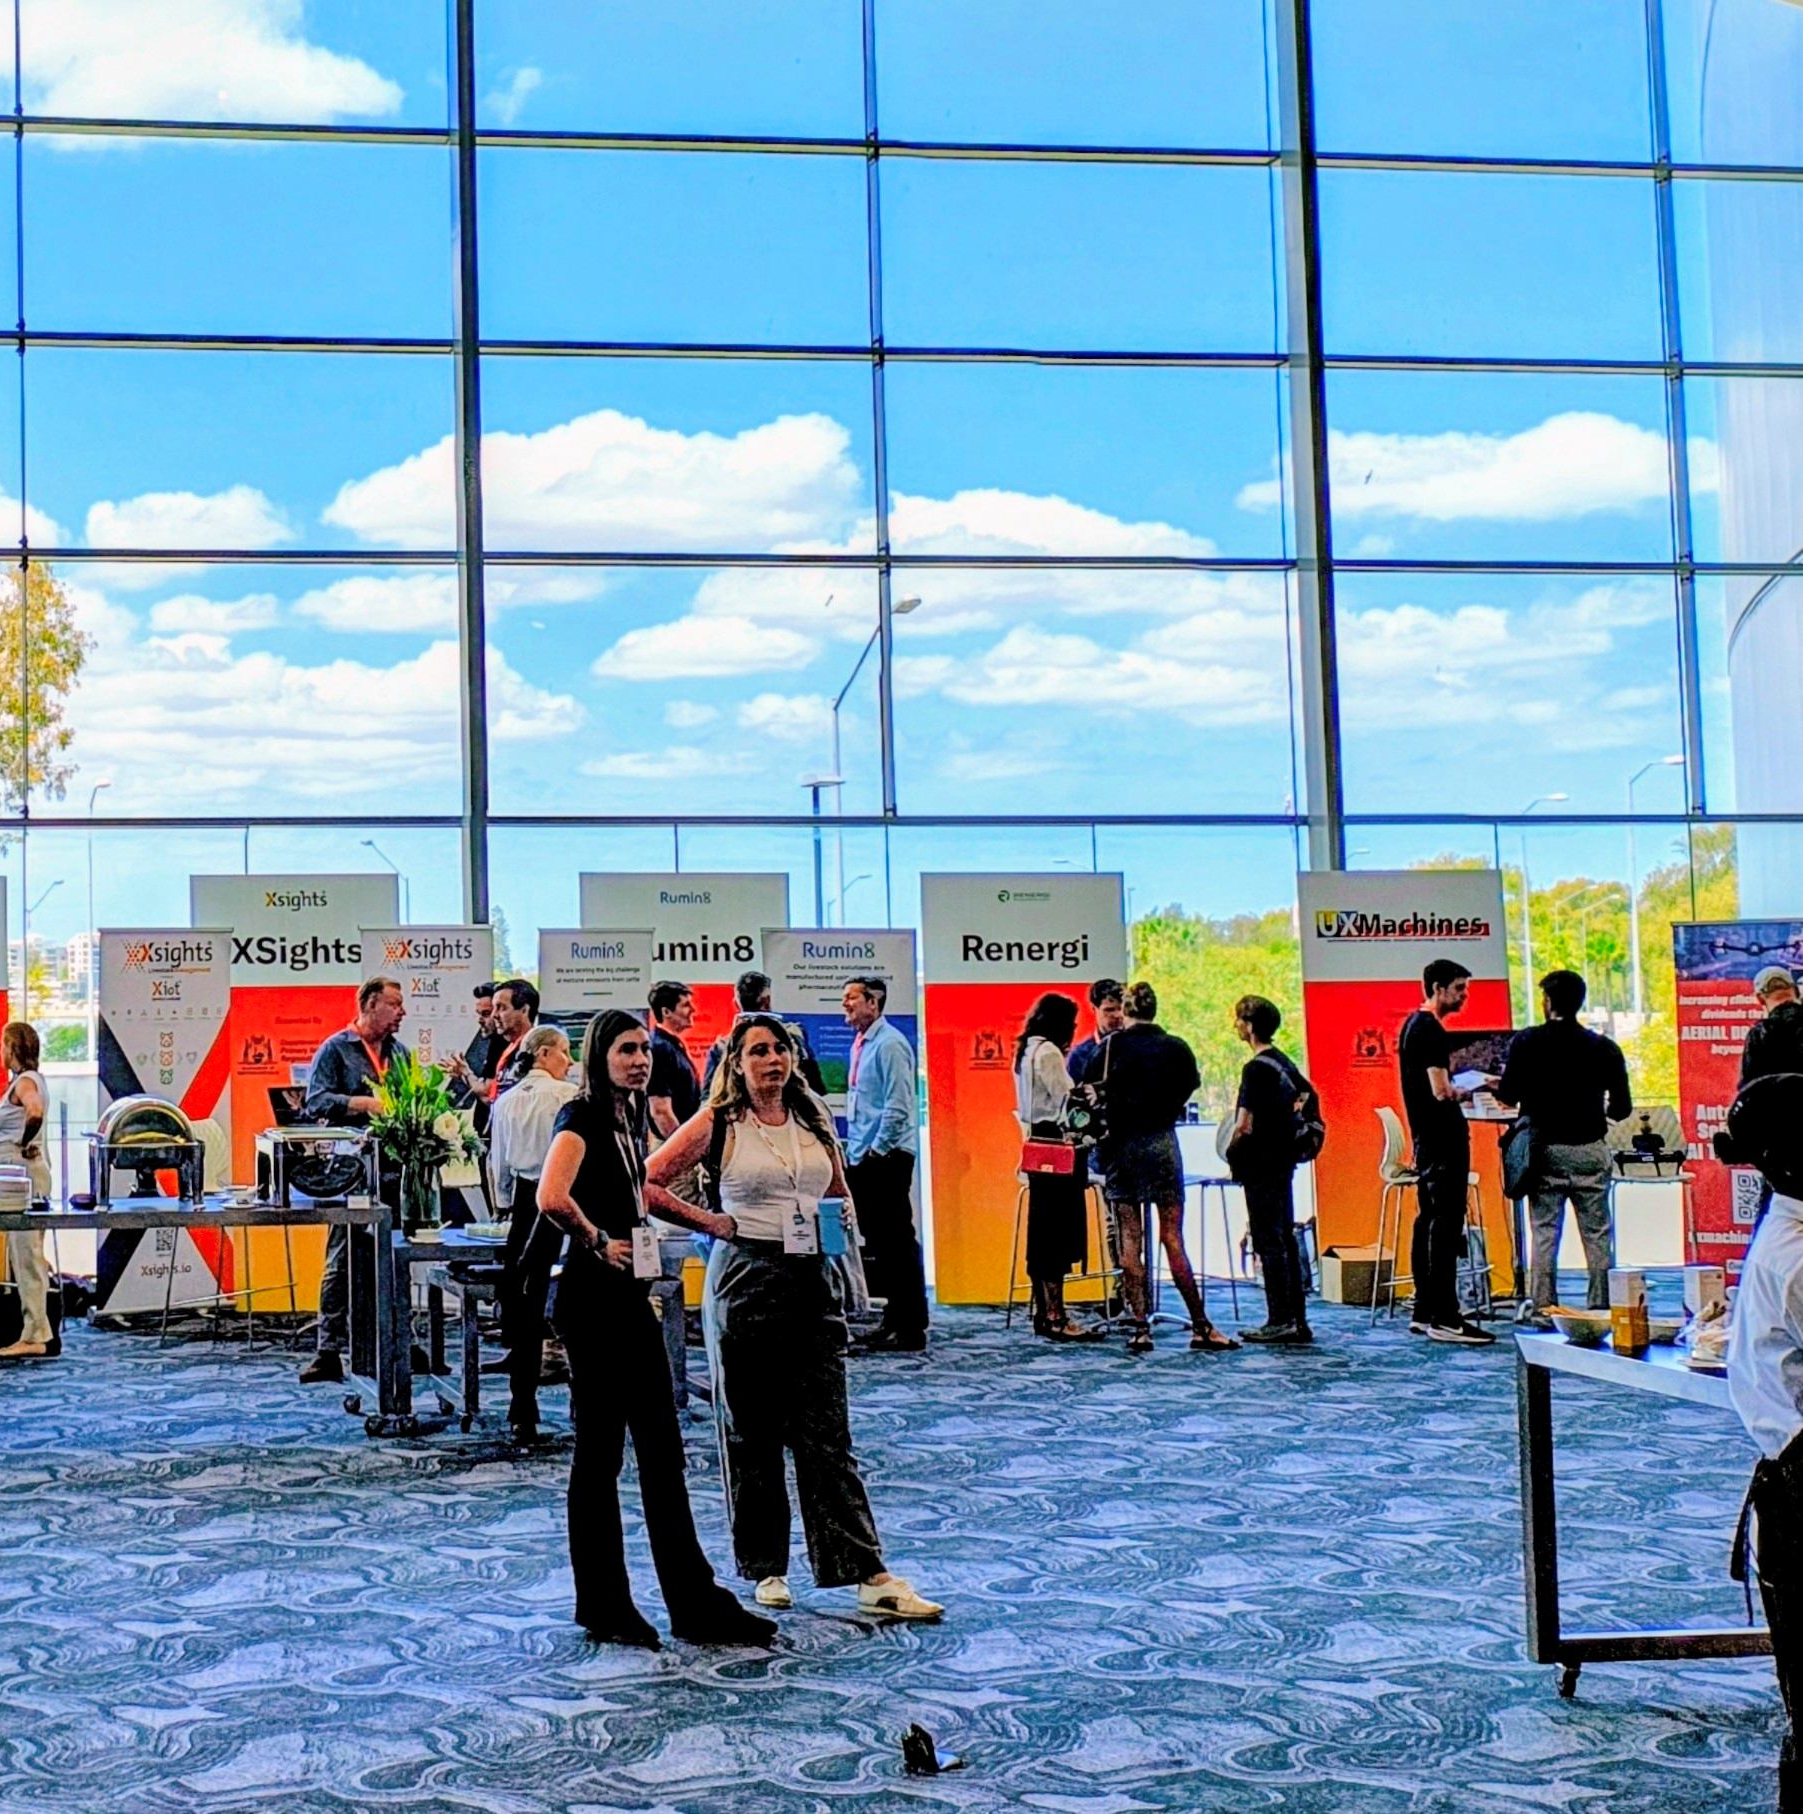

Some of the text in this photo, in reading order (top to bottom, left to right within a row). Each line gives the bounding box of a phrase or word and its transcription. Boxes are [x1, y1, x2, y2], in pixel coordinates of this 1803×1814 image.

[265, 890, 327, 911] Xsights
[660, 891, 712, 904] Rumin8
[1317, 912, 1486, 937] UXMachines
[141, 941, 213, 968] Xsights
[231, 937, 362, 971] XSights
[399, 938, 473, 965] Xsights
[571, 942, 625, 959] Rumin8
[652, 935, 755, 962] umin8
[803, 942, 875, 958] Rumin8
[962, 934, 1089, 968] Renergi
[1681, 1026, 1729, 1040] AERIAL
[141, 1264, 192, 1279] Xsighs.io
